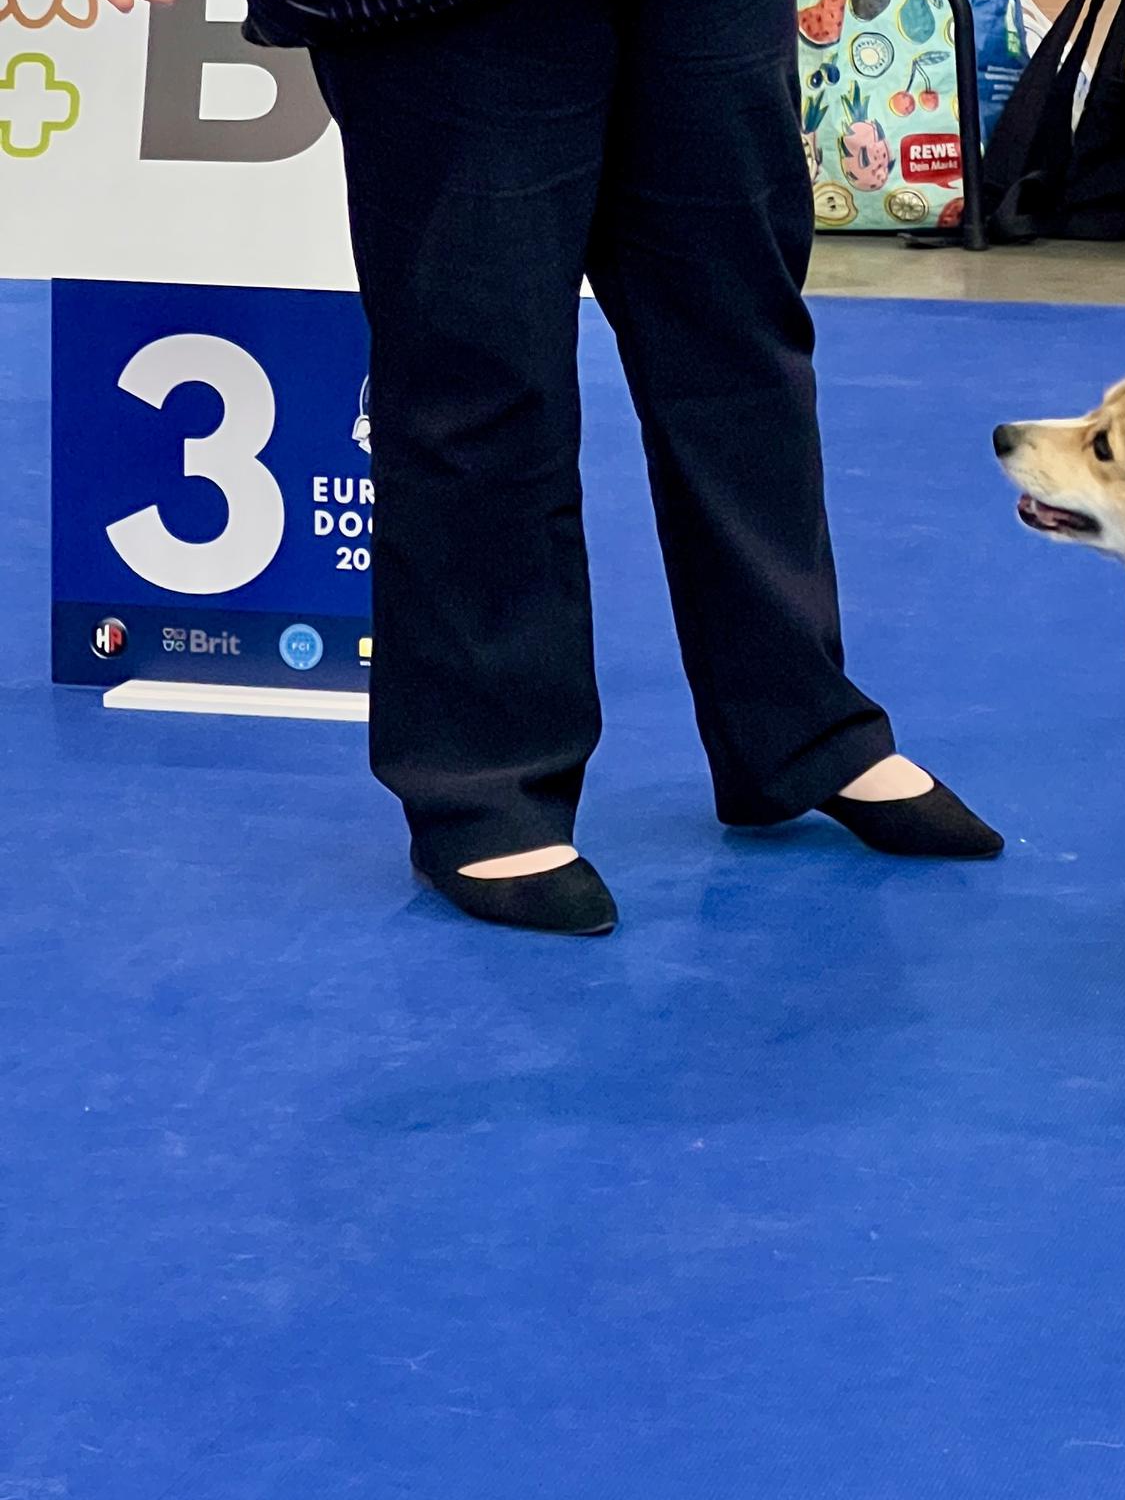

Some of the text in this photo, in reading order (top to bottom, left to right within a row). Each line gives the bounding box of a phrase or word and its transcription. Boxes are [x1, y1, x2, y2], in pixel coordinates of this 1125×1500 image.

[910, 143, 958, 160] REWE
[106, 333, 285, 595] 3
[190, 629, 241, 656] Brit
